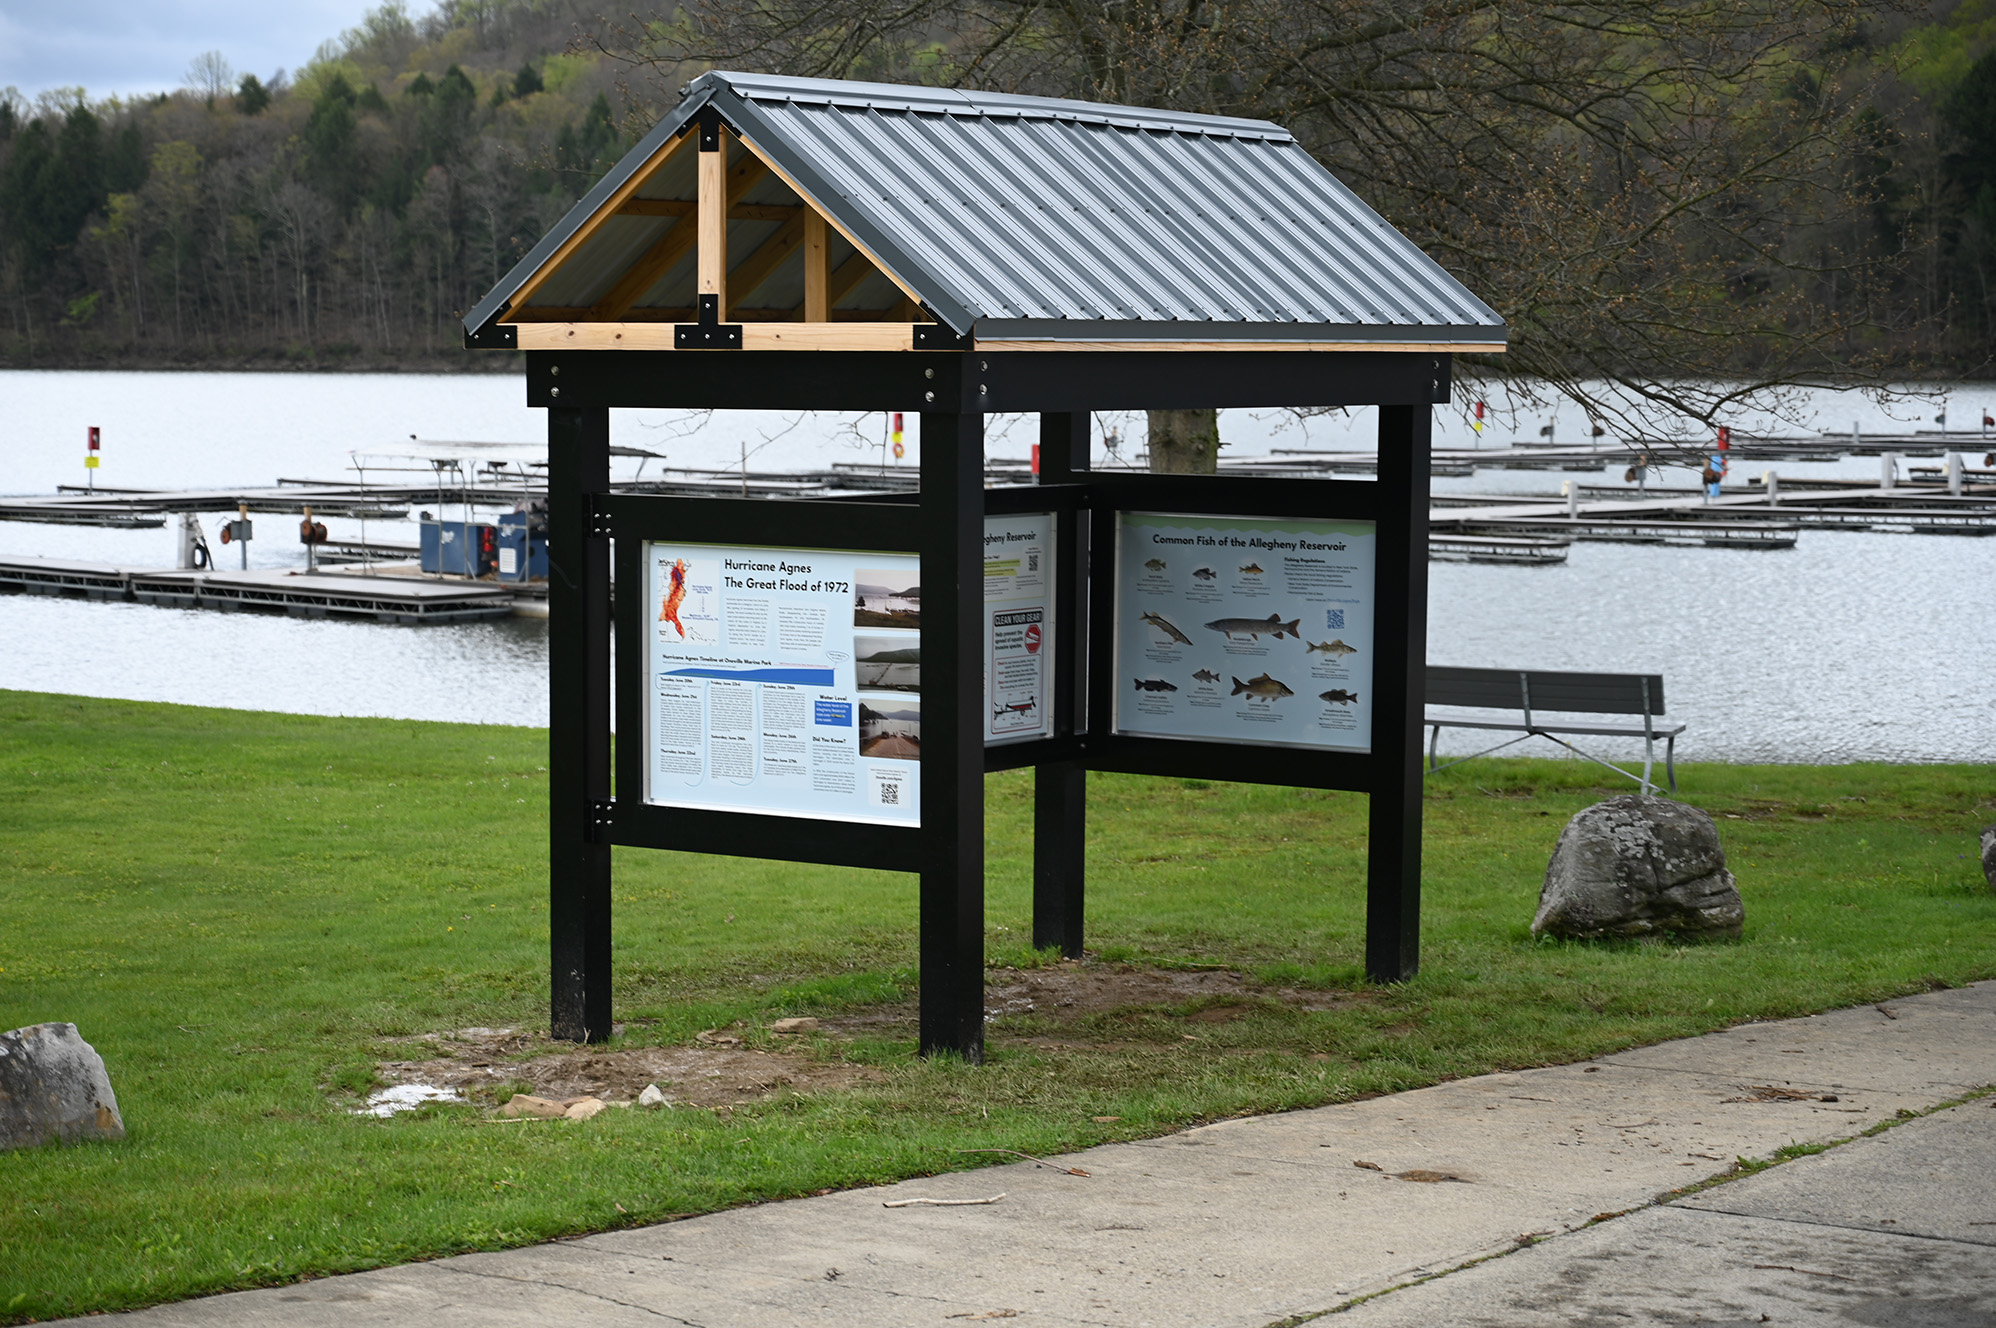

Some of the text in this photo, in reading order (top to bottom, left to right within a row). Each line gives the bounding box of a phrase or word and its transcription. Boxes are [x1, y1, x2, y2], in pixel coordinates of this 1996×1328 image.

[1006, 531, 1036, 542] Reservoir
[1153, 534, 1346, 551] Common Fish of the Allegheny Reservoir
[724, 559, 812, 575] Hurricane Agnes
[724, 577, 849, 593] The Great Flood of 1972
[995, 615, 1013, 625] CLEAN
[1013, 614, 1026, 624] YOUR
